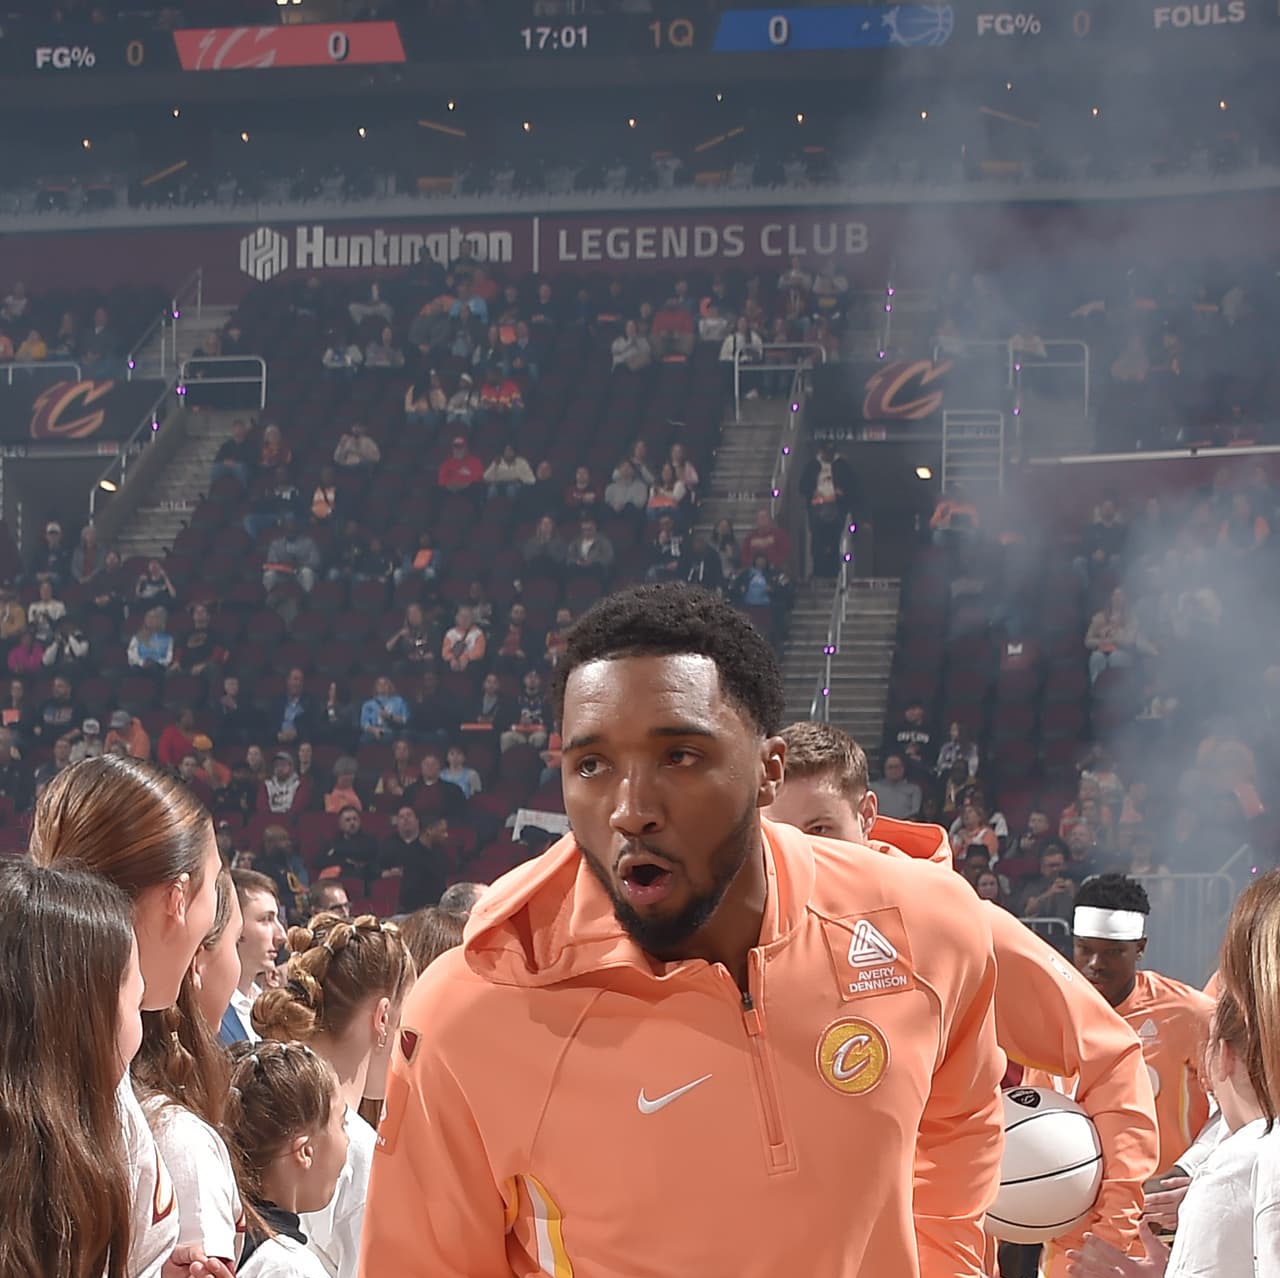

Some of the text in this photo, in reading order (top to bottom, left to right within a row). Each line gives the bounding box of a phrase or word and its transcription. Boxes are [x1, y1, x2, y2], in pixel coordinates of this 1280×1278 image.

[977, 13, 1041, 35] FG%
[1154, 2, 1246, 28] FOULS
[521, 26, 588, 49] 17:01
[648, 19, 695, 48] 1Q
[768, 15, 790, 45] 0
[36, 41, 144, 68] FG% 0
[328, 31, 349, 60] 0
[296, 226, 512, 271] Huntington
[559, 223, 869, 261] LEGENDS CLUB
[849, 975, 908, 994] DENNISON
[858, 966, 896, 982] AVERY
